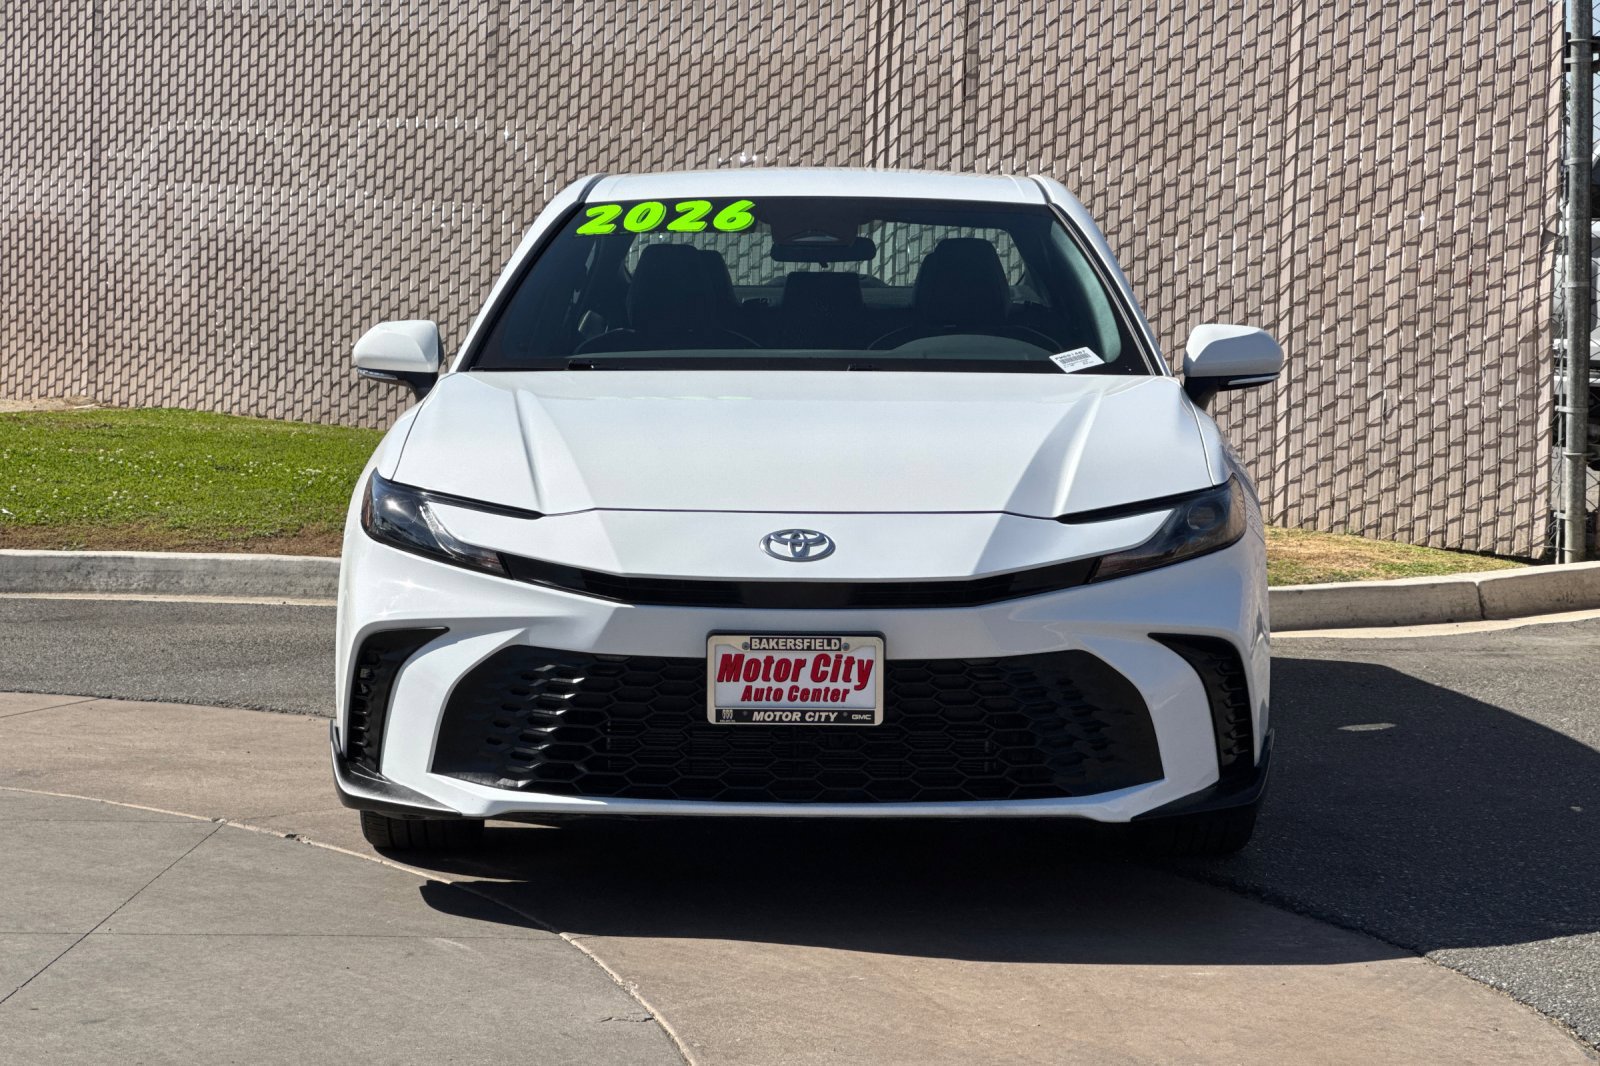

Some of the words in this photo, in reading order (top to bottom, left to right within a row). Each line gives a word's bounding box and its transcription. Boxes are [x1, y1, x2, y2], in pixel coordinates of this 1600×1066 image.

[576, 200, 756, 235] 2026
[751, 638, 840, 650] BAKERSFIELD
[716, 653, 807, 683] Motor
[810, 653, 874, 691] City
[741, 685, 784, 702] Auto
[787, 685, 850, 702] Center
[752, 711, 802, 721] MOTOR
[805, 711, 838, 722] CITY
